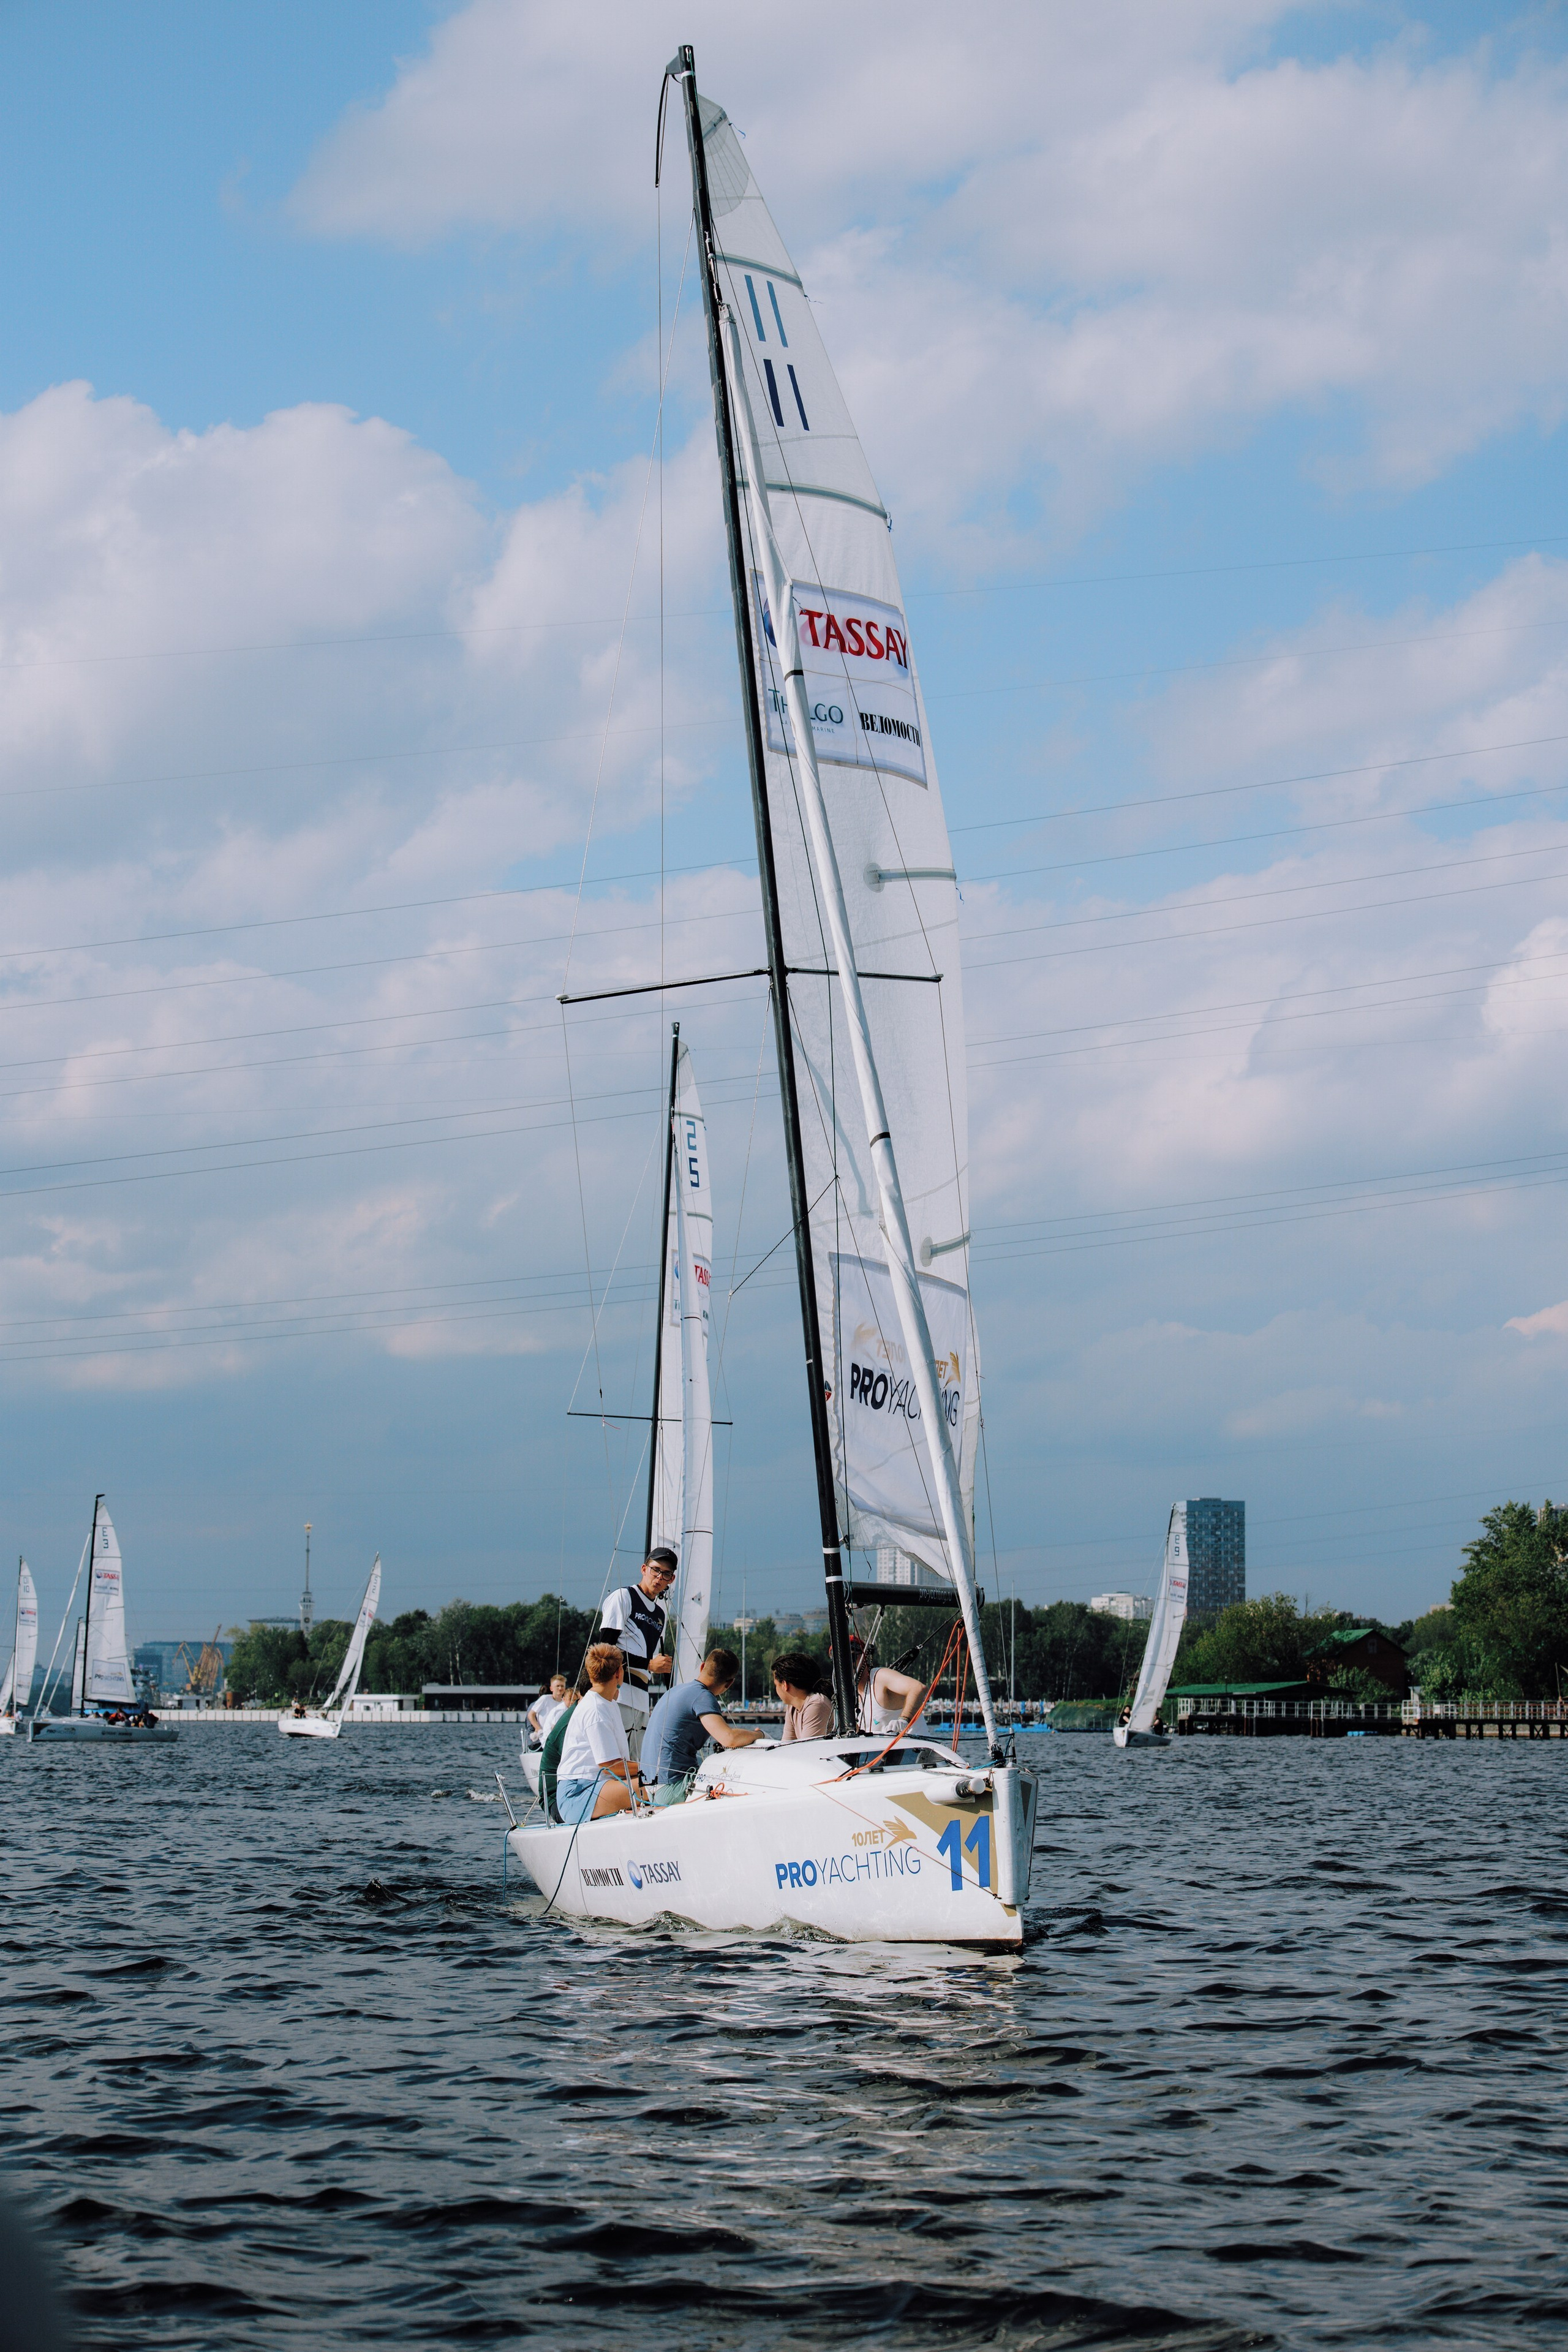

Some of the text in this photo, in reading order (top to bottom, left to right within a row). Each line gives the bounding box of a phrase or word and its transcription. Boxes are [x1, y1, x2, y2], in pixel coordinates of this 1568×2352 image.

[744, 274, 789, 348] 11
[763, 358, 810, 431] 11
[799, 609, 908, 669] TASSAY
[688, 1157, 699, 1188] 5
[640, 1861, 682, 1884] TASSAY
[775, 1846, 921, 1890] PROYACHTING
[937, 1815, 990, 1891] 11
